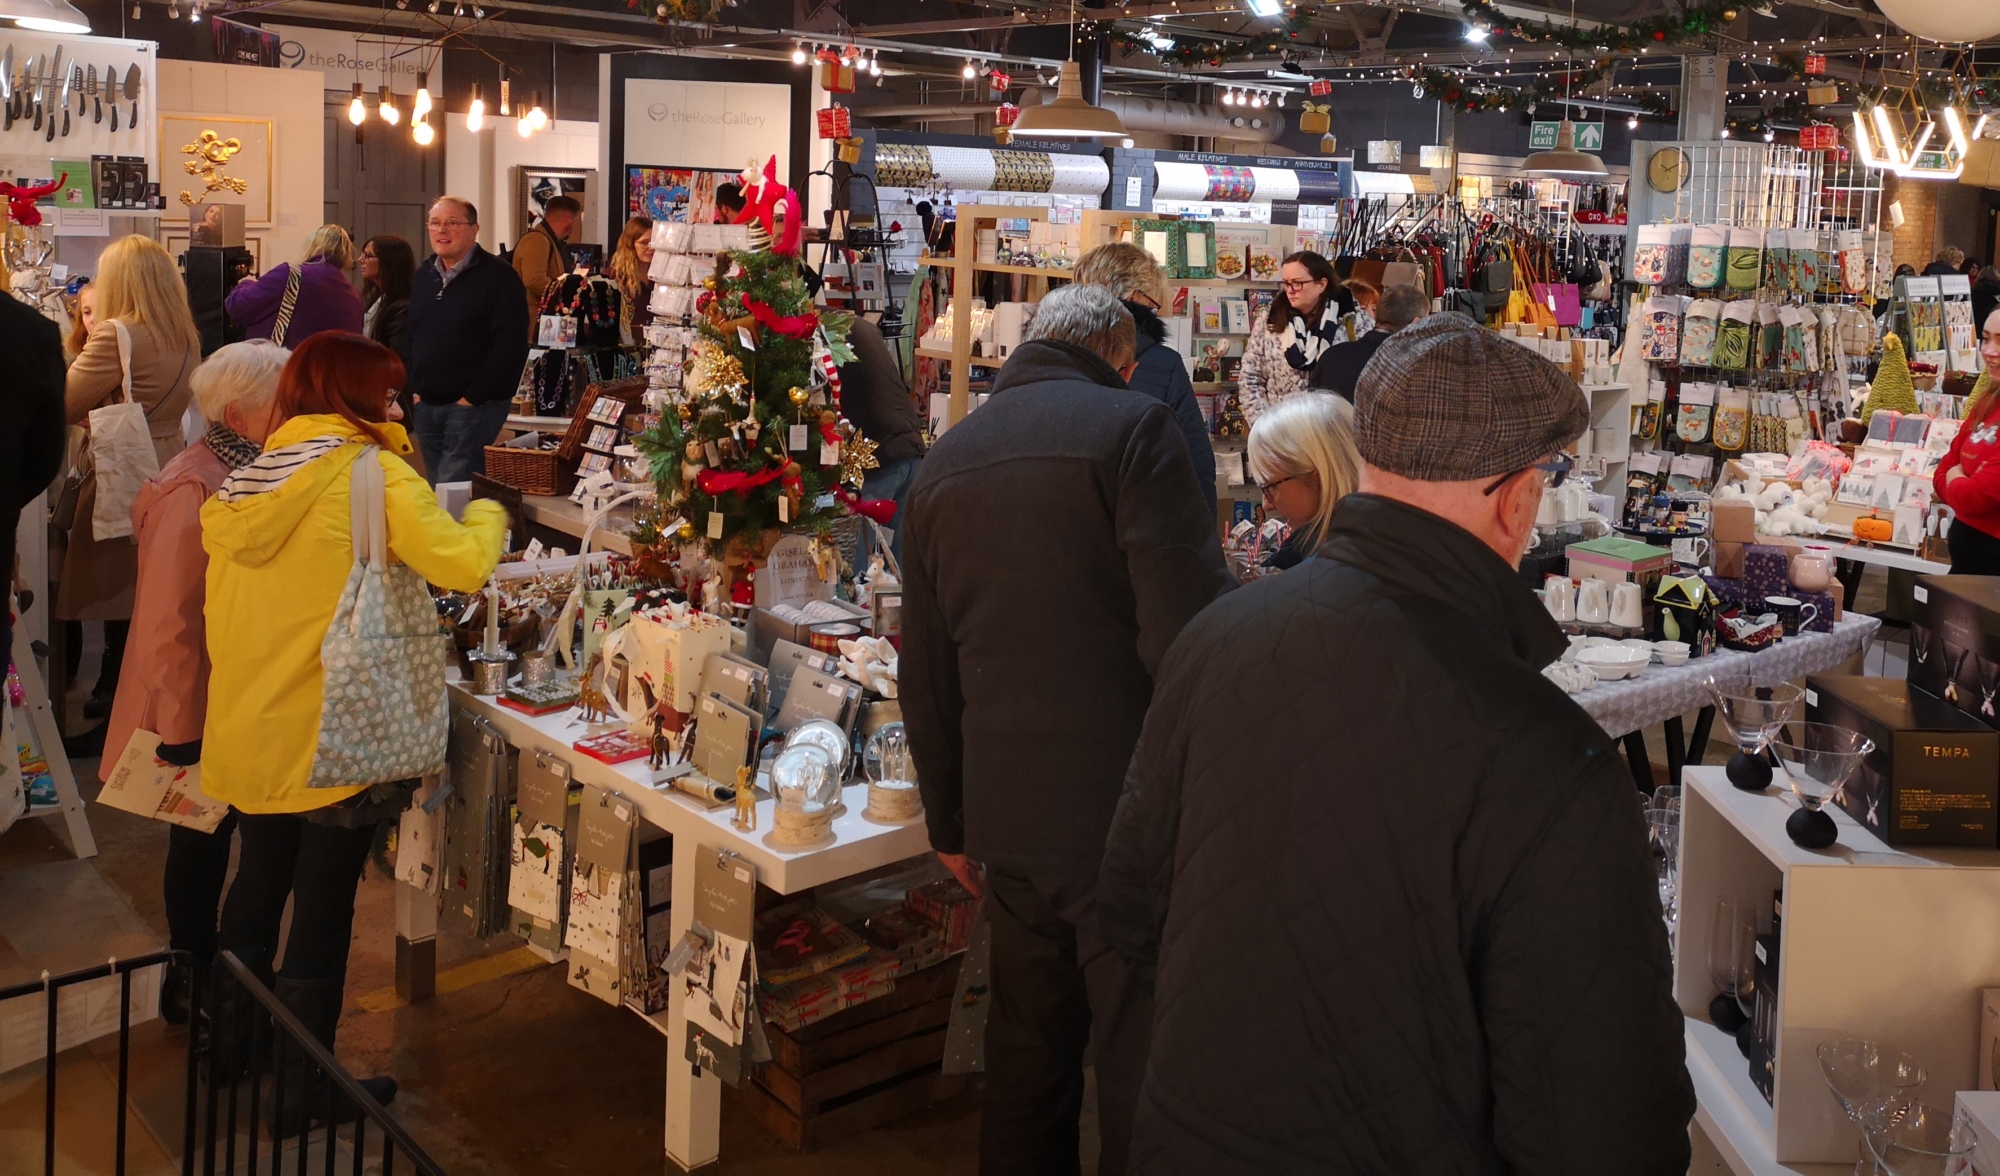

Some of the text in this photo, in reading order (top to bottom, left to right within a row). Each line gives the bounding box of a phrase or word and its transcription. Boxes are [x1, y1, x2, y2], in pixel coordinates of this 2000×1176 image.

[309, 52, 427, 75] theRoseGaller
[672, 110, 766, 128] theRoseGallery
[1534, 125, 1554, 136] Fire
[1011, 139, 1071, 151] FEMALE RELATIVES
[1533, 135, 1553, 145] exit
[1177, 153, 1228, 163] MALE RELATIVES
[1918, 153, 1936, 161] Fire
[1917, 160, 1934, 168] exit
[1588, 212, 1602, 221] OXO
[776, 547, 809, 558] GISEL
[1923, 746, 1970, 758] TEMPA
